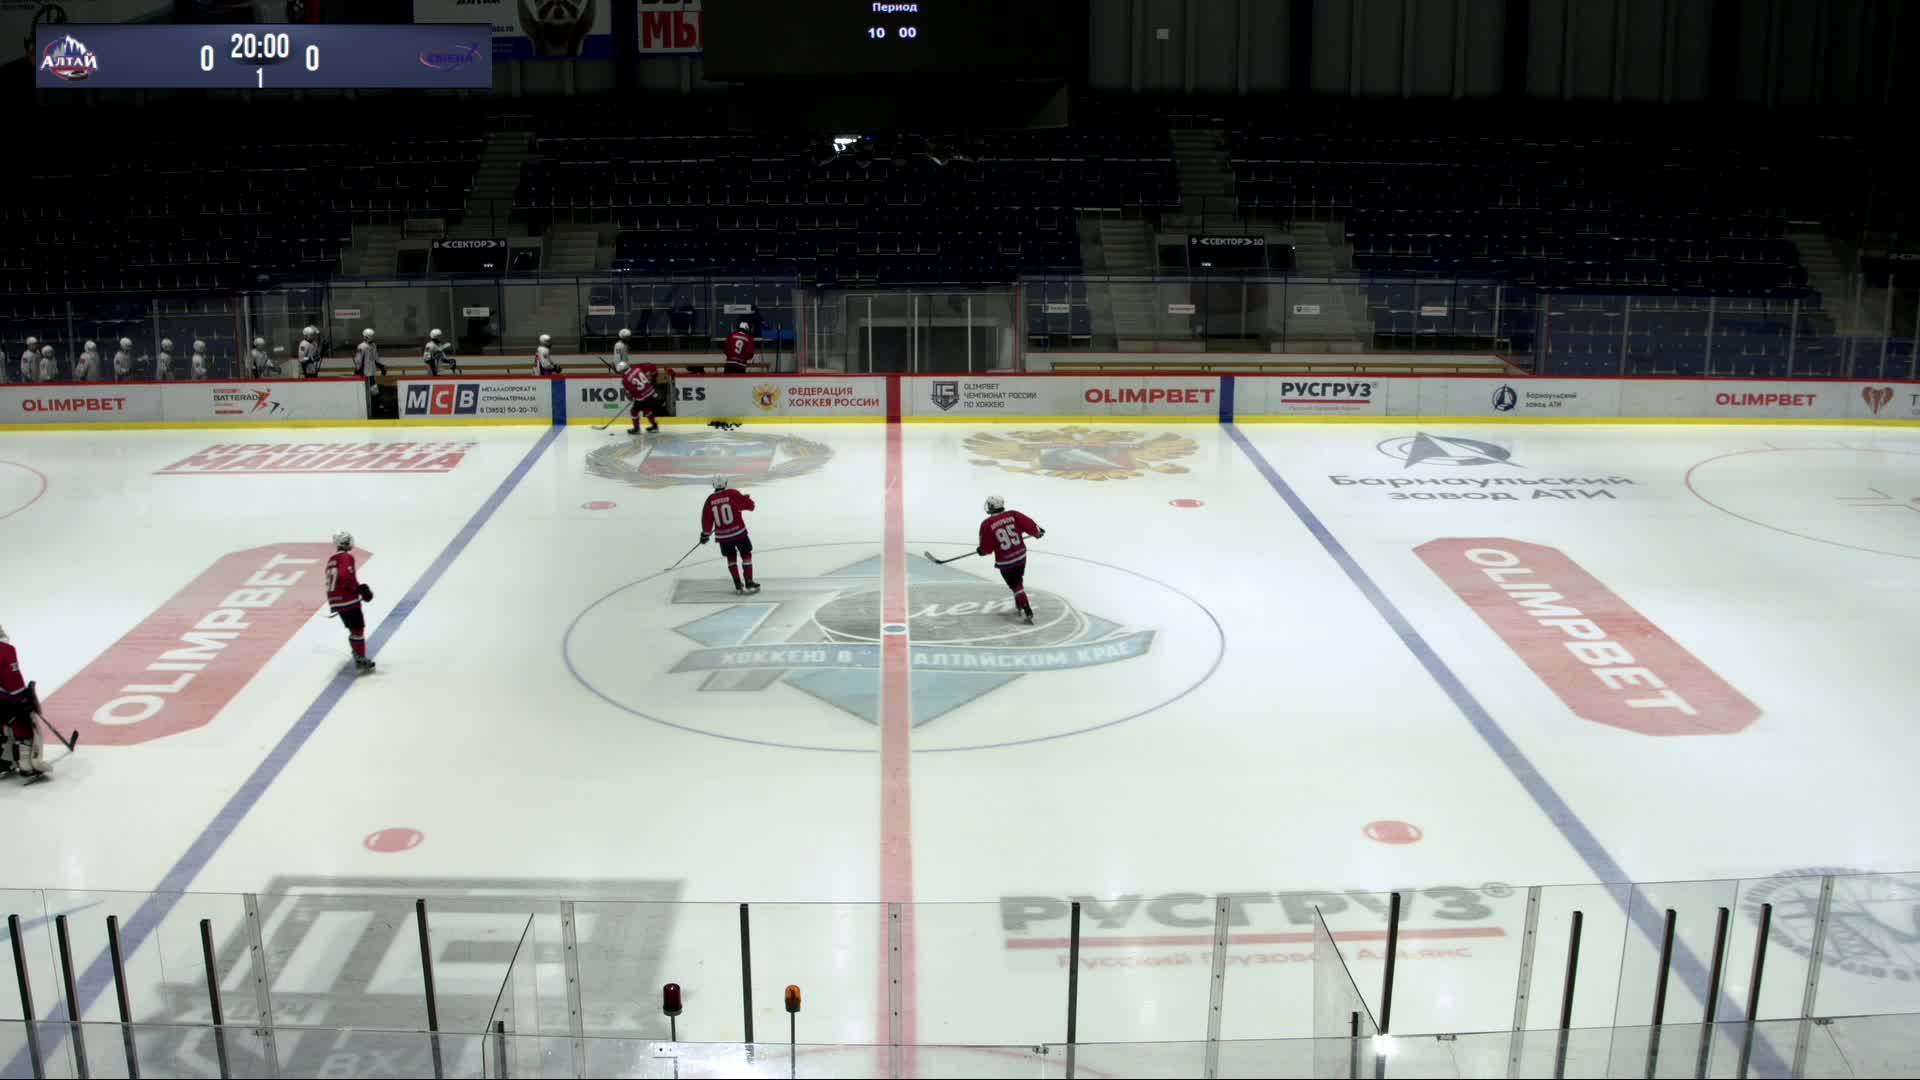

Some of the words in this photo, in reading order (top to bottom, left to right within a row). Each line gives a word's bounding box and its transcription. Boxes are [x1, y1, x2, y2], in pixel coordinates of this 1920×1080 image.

[873, 2, 918, 14] Период
[868, 27, 886, 39] 10
[898, 27, 917, 38] 00
[788, 387, 853, 397] ФЕДЕРАЦИЯ
[1084, 388, 1216, 404] OLIMPBET
[1715, 392, 1817, 406] OLIMPBET
[22, 398, 126, 412] OLIMPBET
[788, 398, 831, 407] ХОККЕЯ
[834, 398, 879, 407] РОССИИ
[1328, 475, 1636, 489] Барнаульский
[1387, 491, 1519, 501] завод
[1531, 488, 1616, 500] АТИ
[711, 503, 734, 527] 10
[995, 524, 1021, 551] 95
[1464, 548, 1698, 715] OLIMPBET
[91, 553, 321, 726] OLIMPBET
